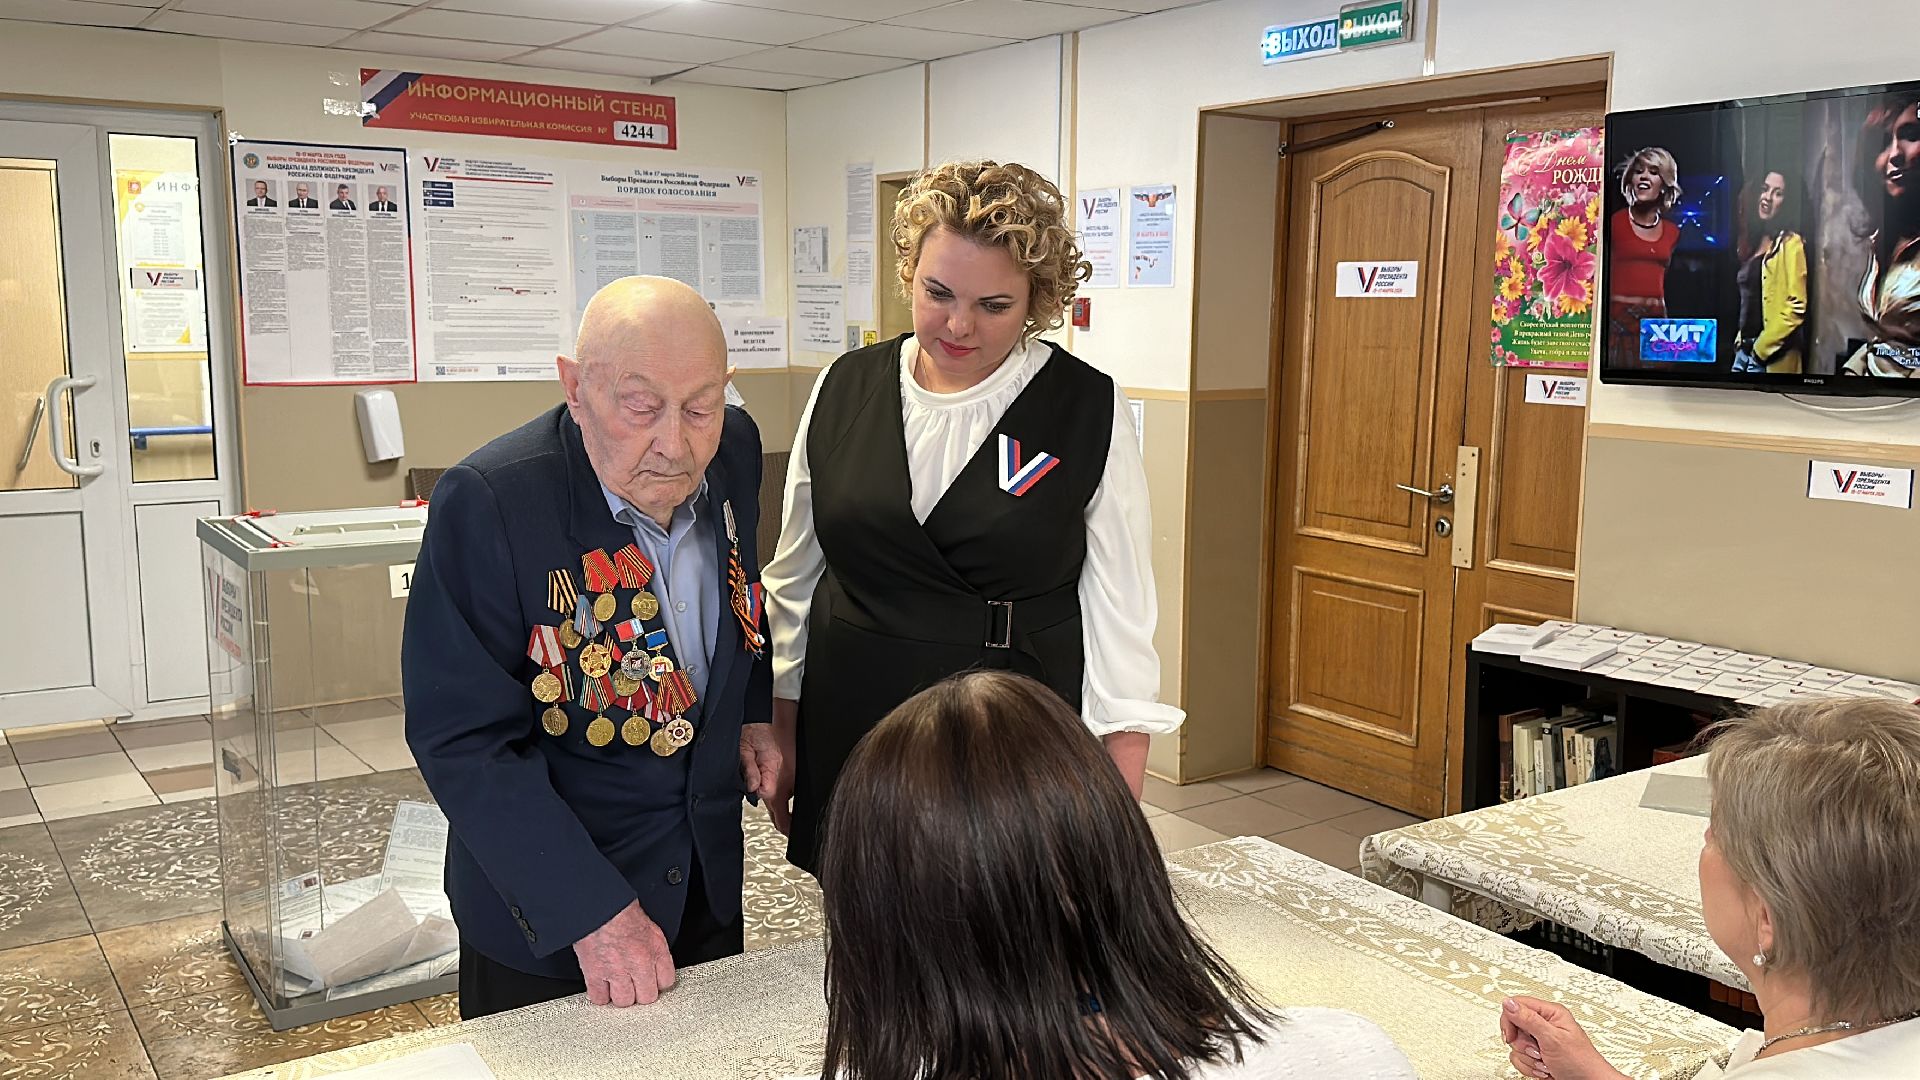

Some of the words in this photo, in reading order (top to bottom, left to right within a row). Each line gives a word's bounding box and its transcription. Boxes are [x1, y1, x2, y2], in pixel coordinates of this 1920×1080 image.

[1270, 22, 1336, 54] ВЫХОД
[1342, 9, 1400, 40] ВЫХОД
[407, 80, 605, 113] ИНФОРМАЦИОННЫЙ
[609, 99, 668, 121] СТЕНД
[409, 111, 470, 124] УЧАСТКОВАЯ
[546, 122, 593, 134] КОМИССИЯ
[621, 123, 654, 139] 4244
[601, 174, 627, 184] Выборы
[627, 176, 664, 185] Президента
[664, 178, 698, 187] Российской
[617, 186, 656, 195] ПОРЯДОК
[658, 188, 717, 197] ГОЛОСОВАНИЯ
[1649, 324, 1706, 343] ХИТ
